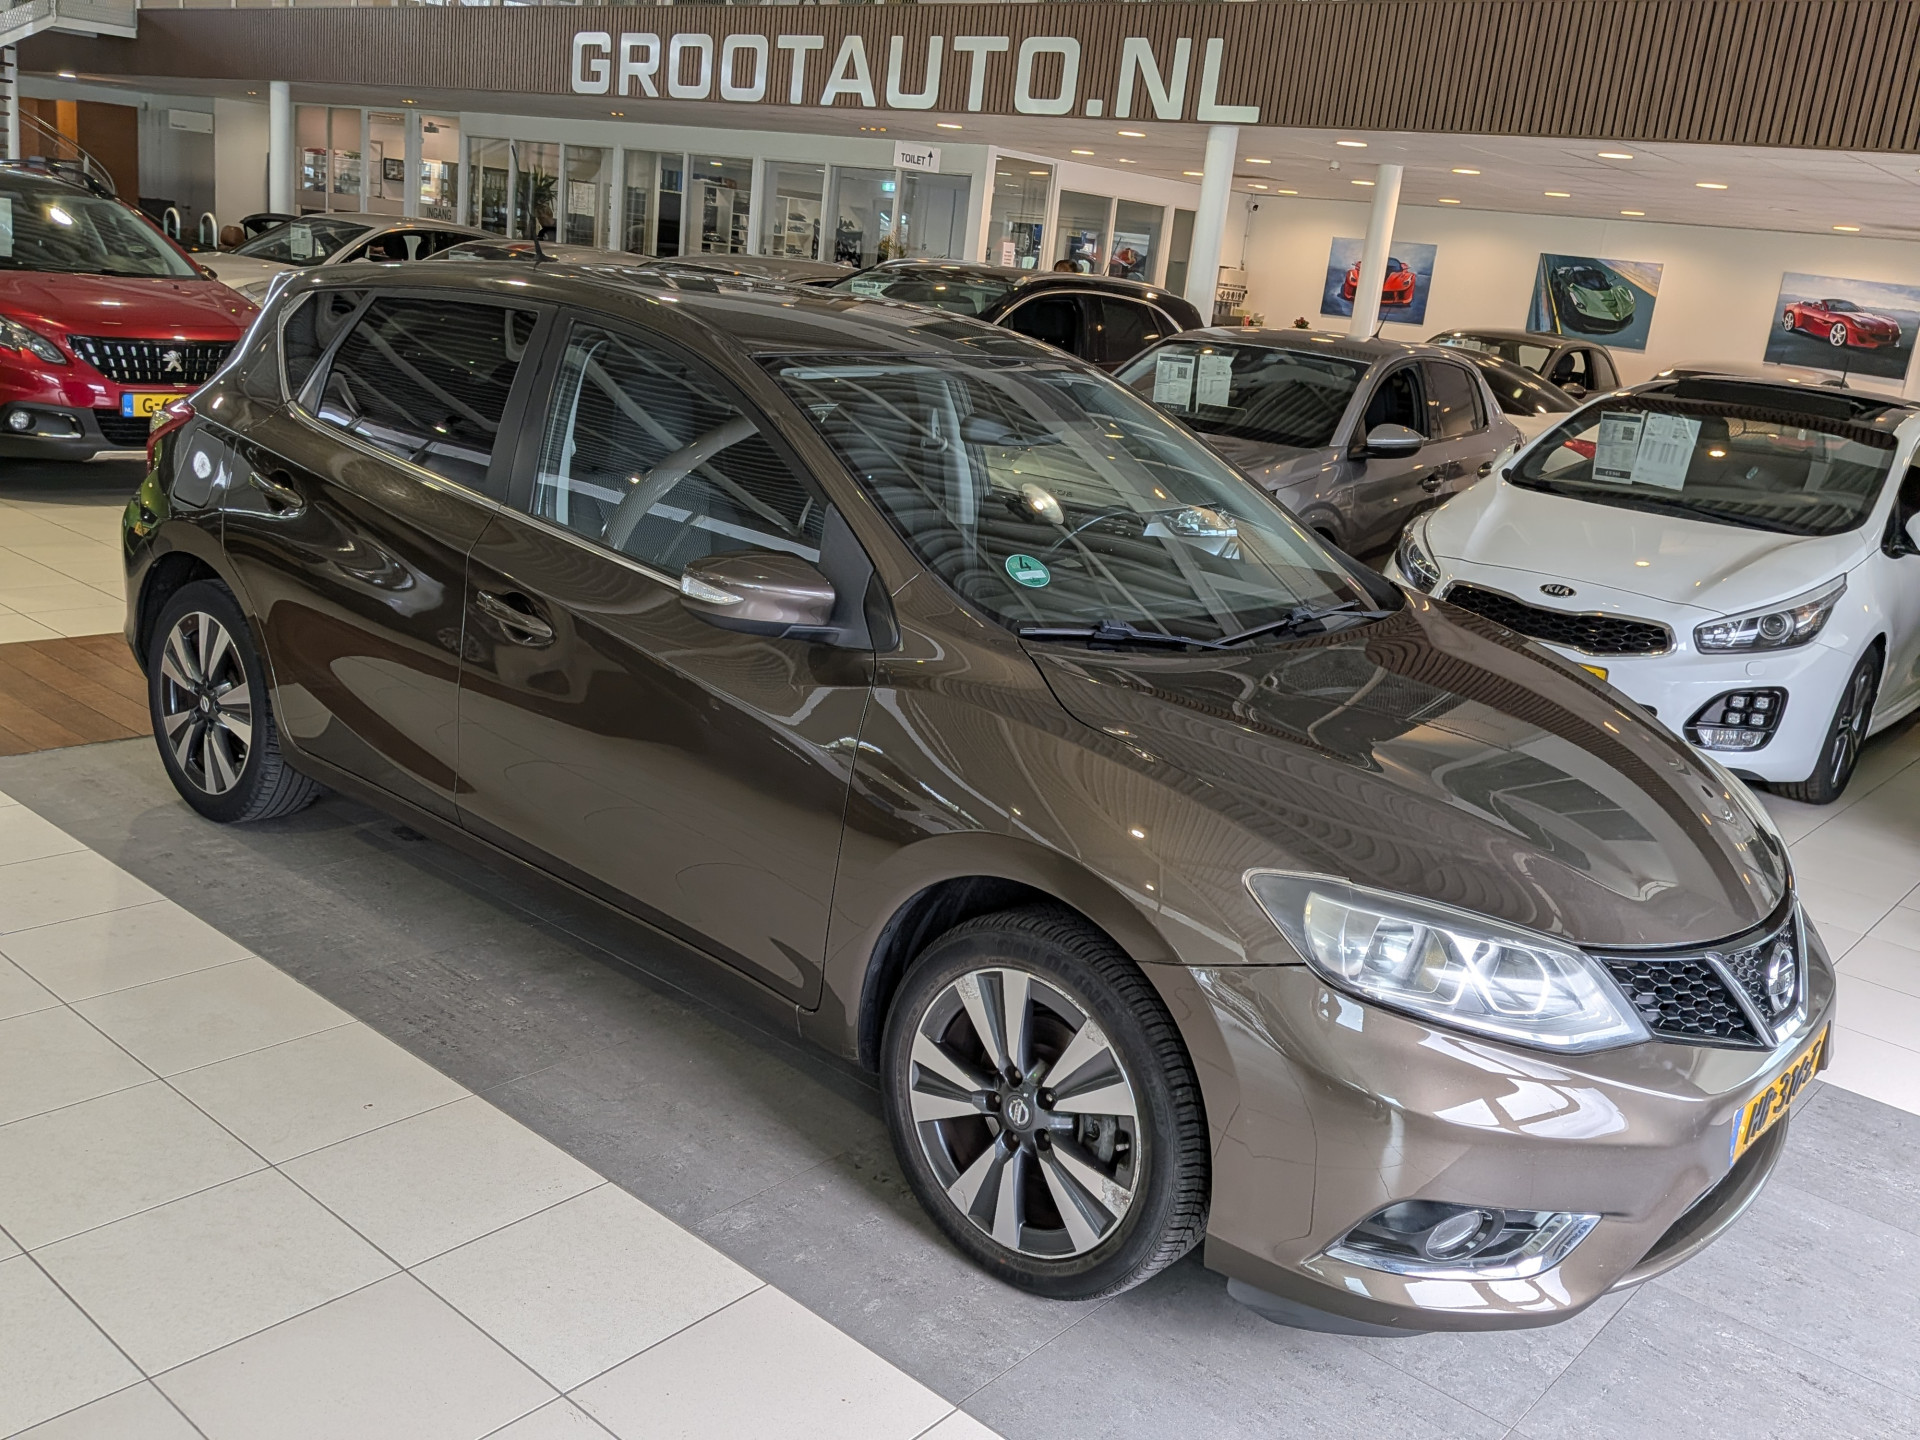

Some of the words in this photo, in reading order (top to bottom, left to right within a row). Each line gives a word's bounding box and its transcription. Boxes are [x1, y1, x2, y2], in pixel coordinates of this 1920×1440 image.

[571, 31, 1261, 123] GROOTAUTO.NL
[900, 152, 927, 166] TOILET
[426, 207, 452, 221] INGANG
[1544, 584, 1570, 596] KIA
